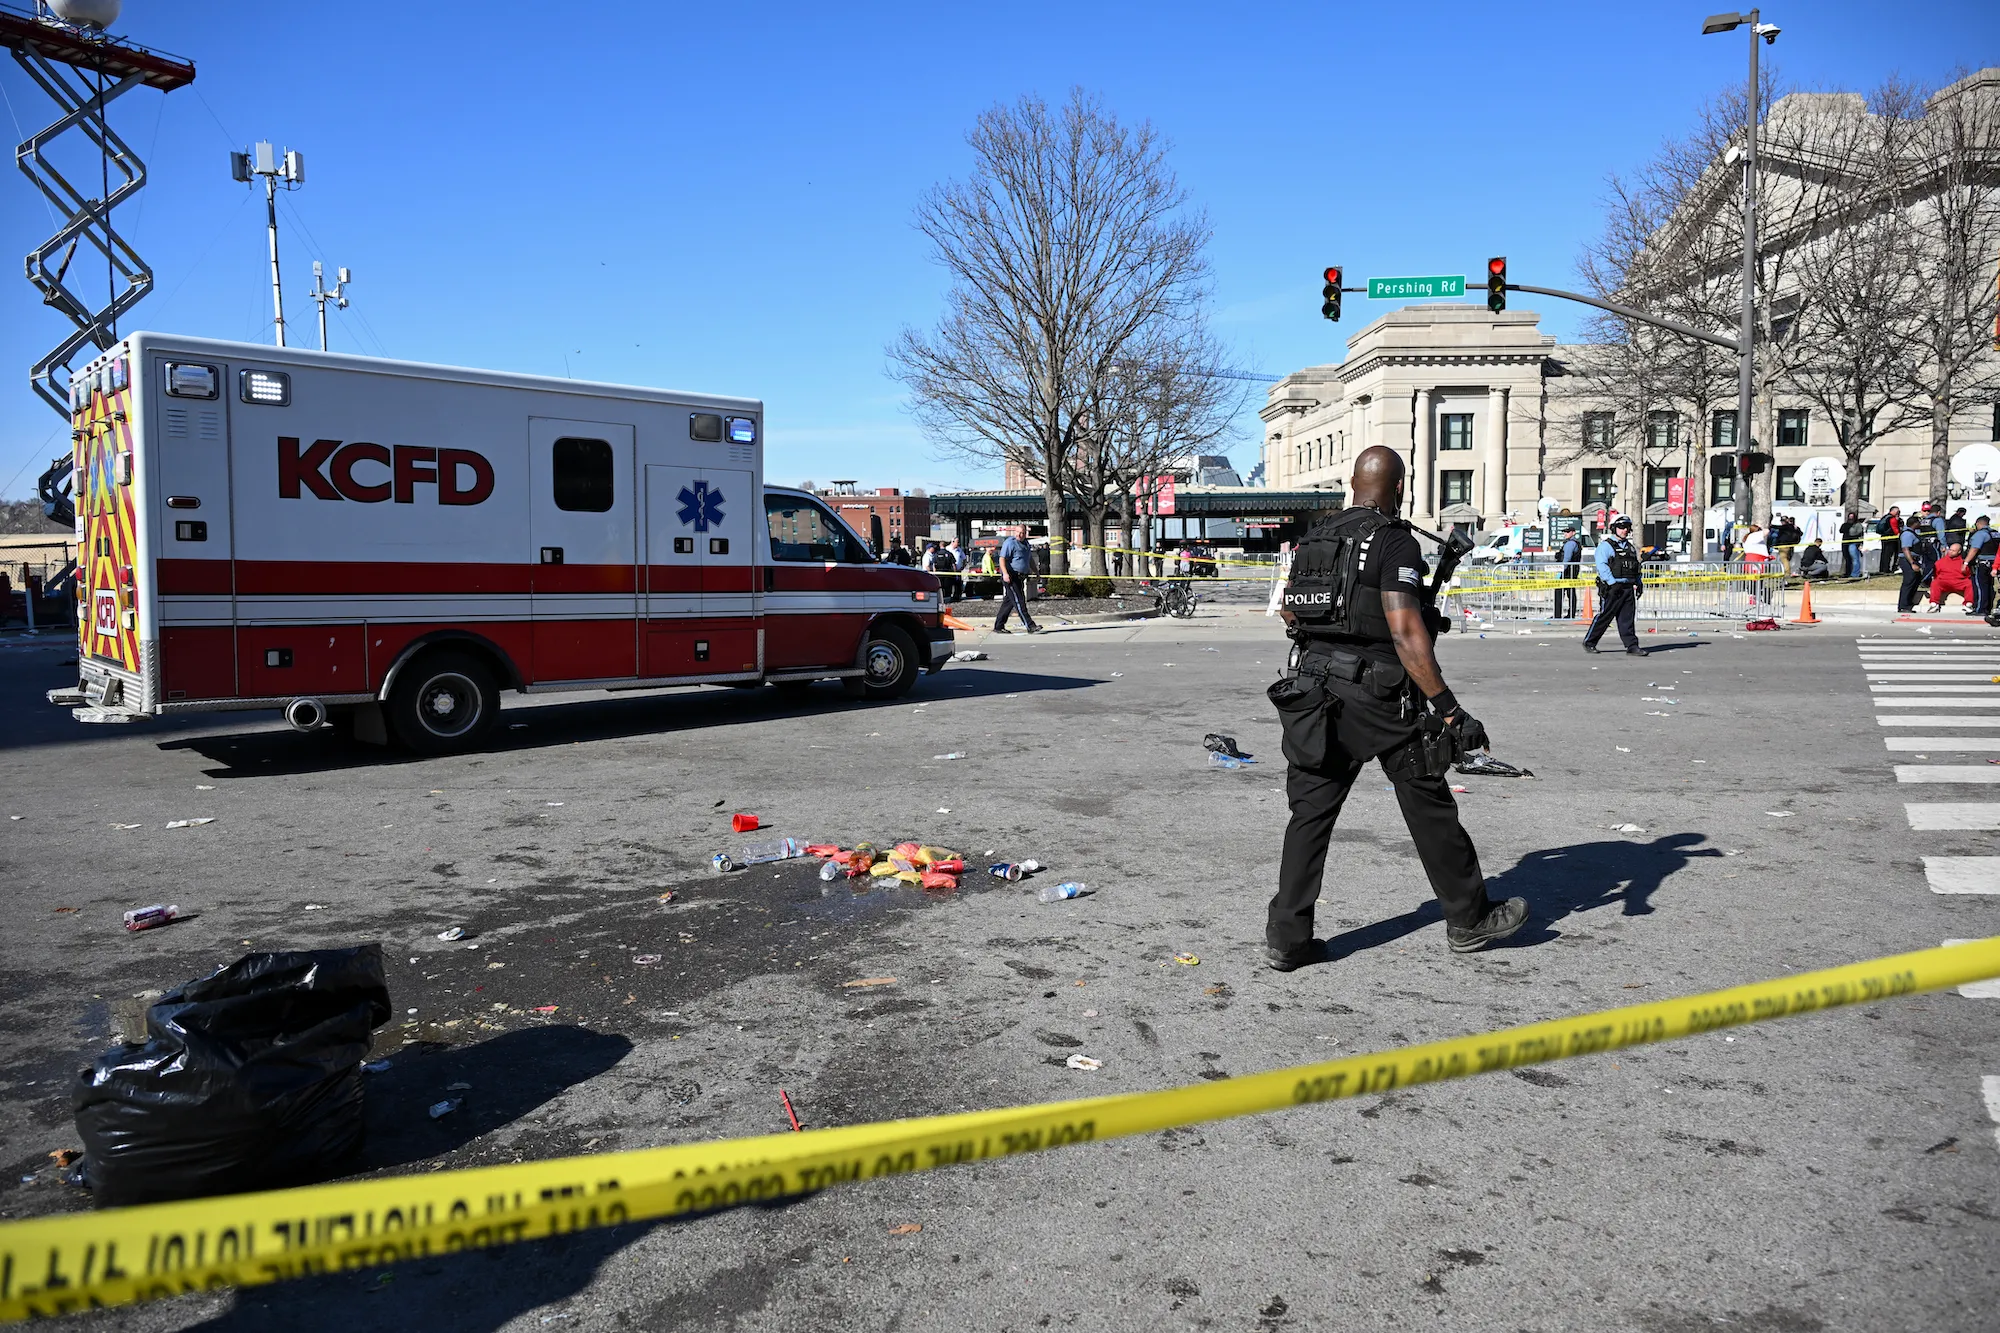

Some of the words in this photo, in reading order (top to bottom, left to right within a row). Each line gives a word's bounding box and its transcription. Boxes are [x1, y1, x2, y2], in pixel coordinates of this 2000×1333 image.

[1376, 281, 1433, 296] Pershing
[1441, 281, 1457, 292] Rd
[277, 436, 495, 506] KCFD
[1285, 592, 1331, 606] POLICE
[96, 594, 116, 630] KCFD
